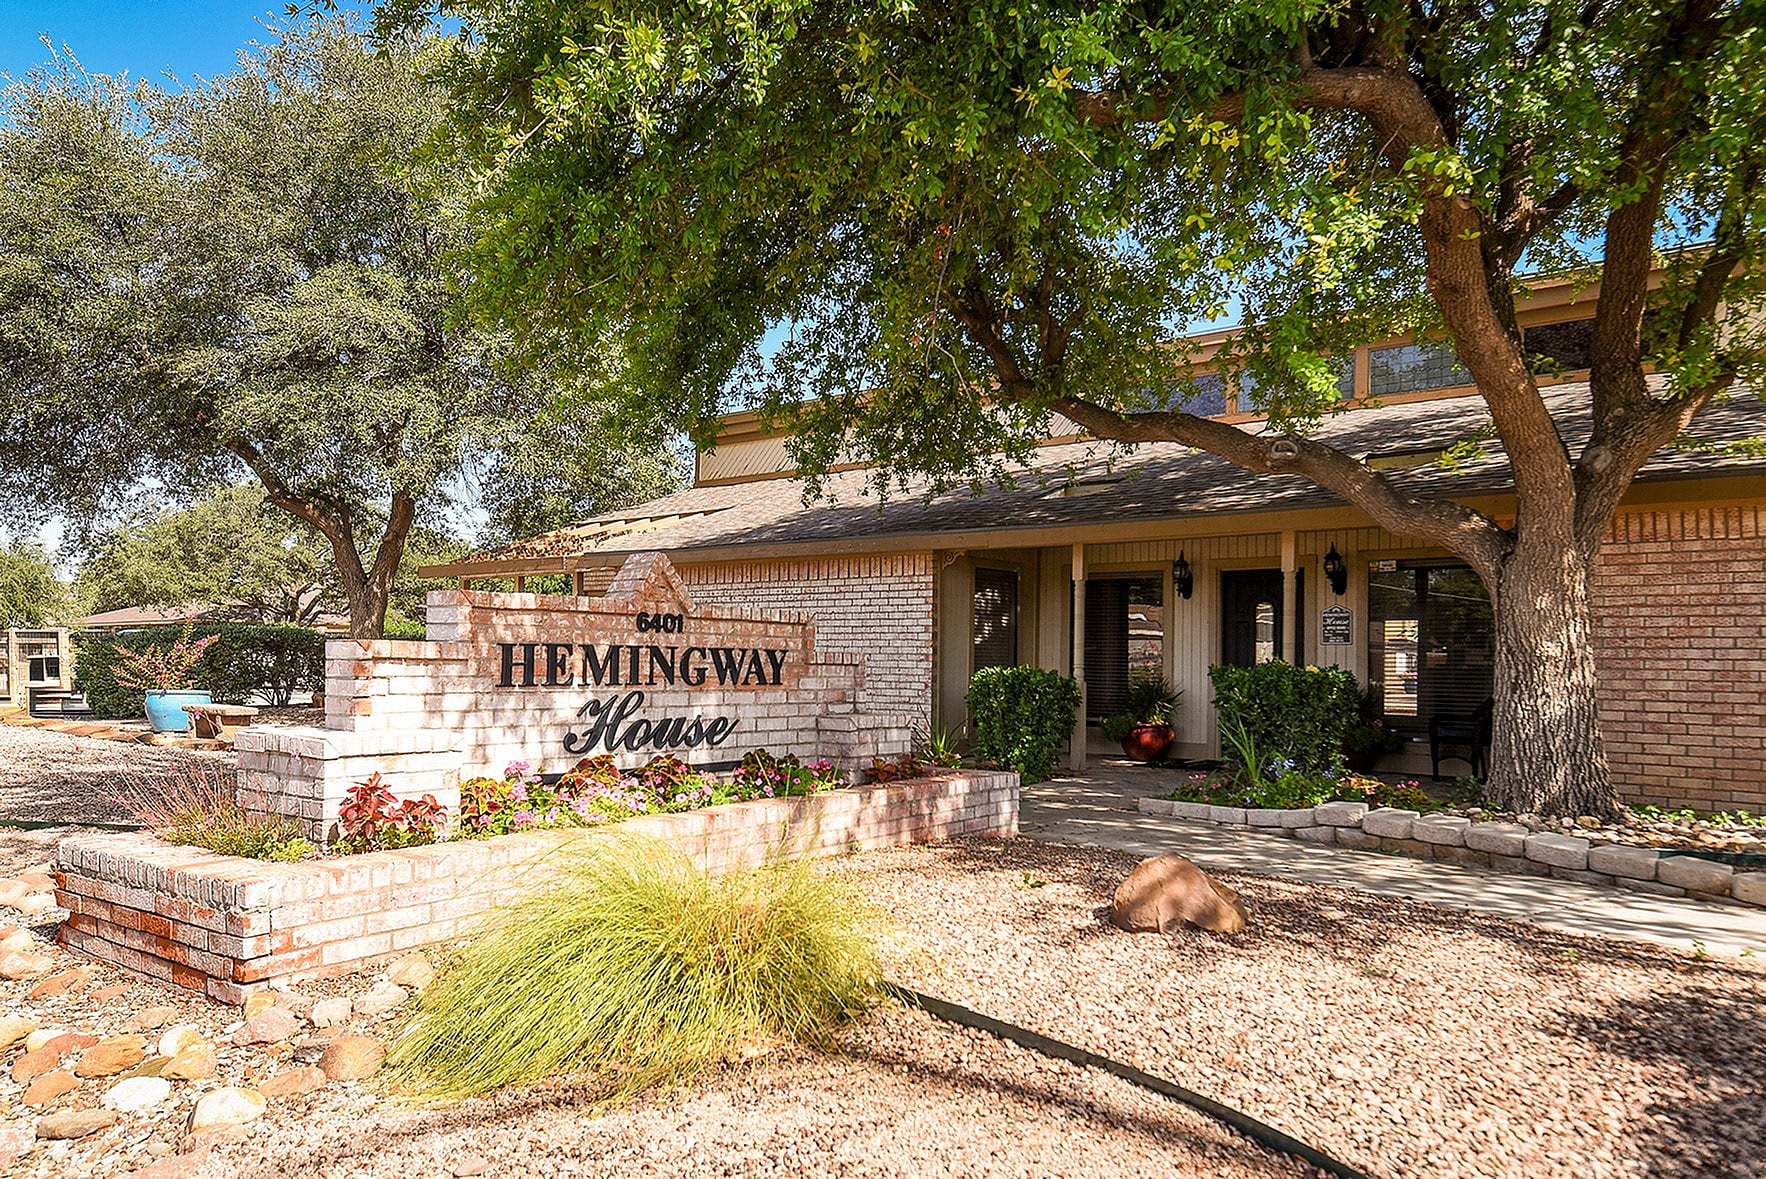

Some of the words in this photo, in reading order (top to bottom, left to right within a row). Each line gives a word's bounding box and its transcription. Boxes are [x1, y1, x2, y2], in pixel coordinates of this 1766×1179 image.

[636, 613, 683, 633] 6401
[495, 642, 788, 688] HEMINGWAY
[564, 690, 740, 754] House
